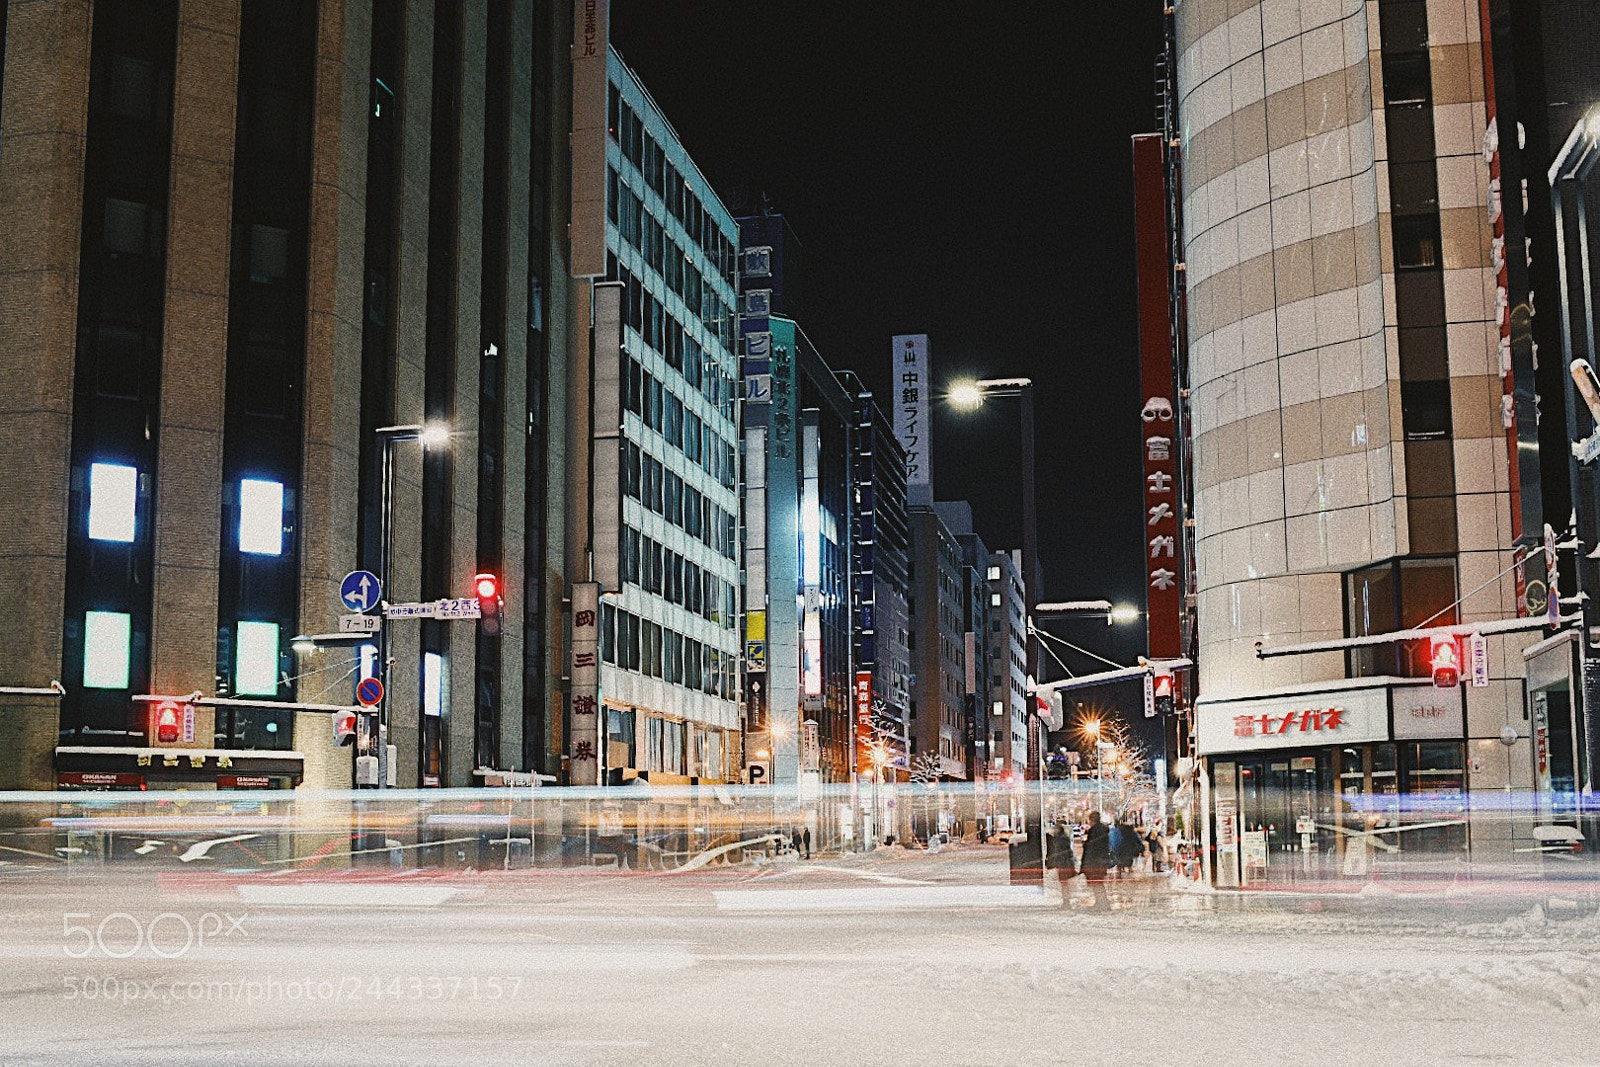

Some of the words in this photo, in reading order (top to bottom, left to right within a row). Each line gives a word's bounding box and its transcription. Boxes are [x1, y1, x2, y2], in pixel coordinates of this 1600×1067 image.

[902, 371, 919, 478] 中銀ライフケア
[1145, 436, 1176, 591] 富士メガネ
[573, 610, 597, 761] 岡三證券
[1232, 707, 1345, 738] 富士メガネ
[750, 765, 765, 785] P
